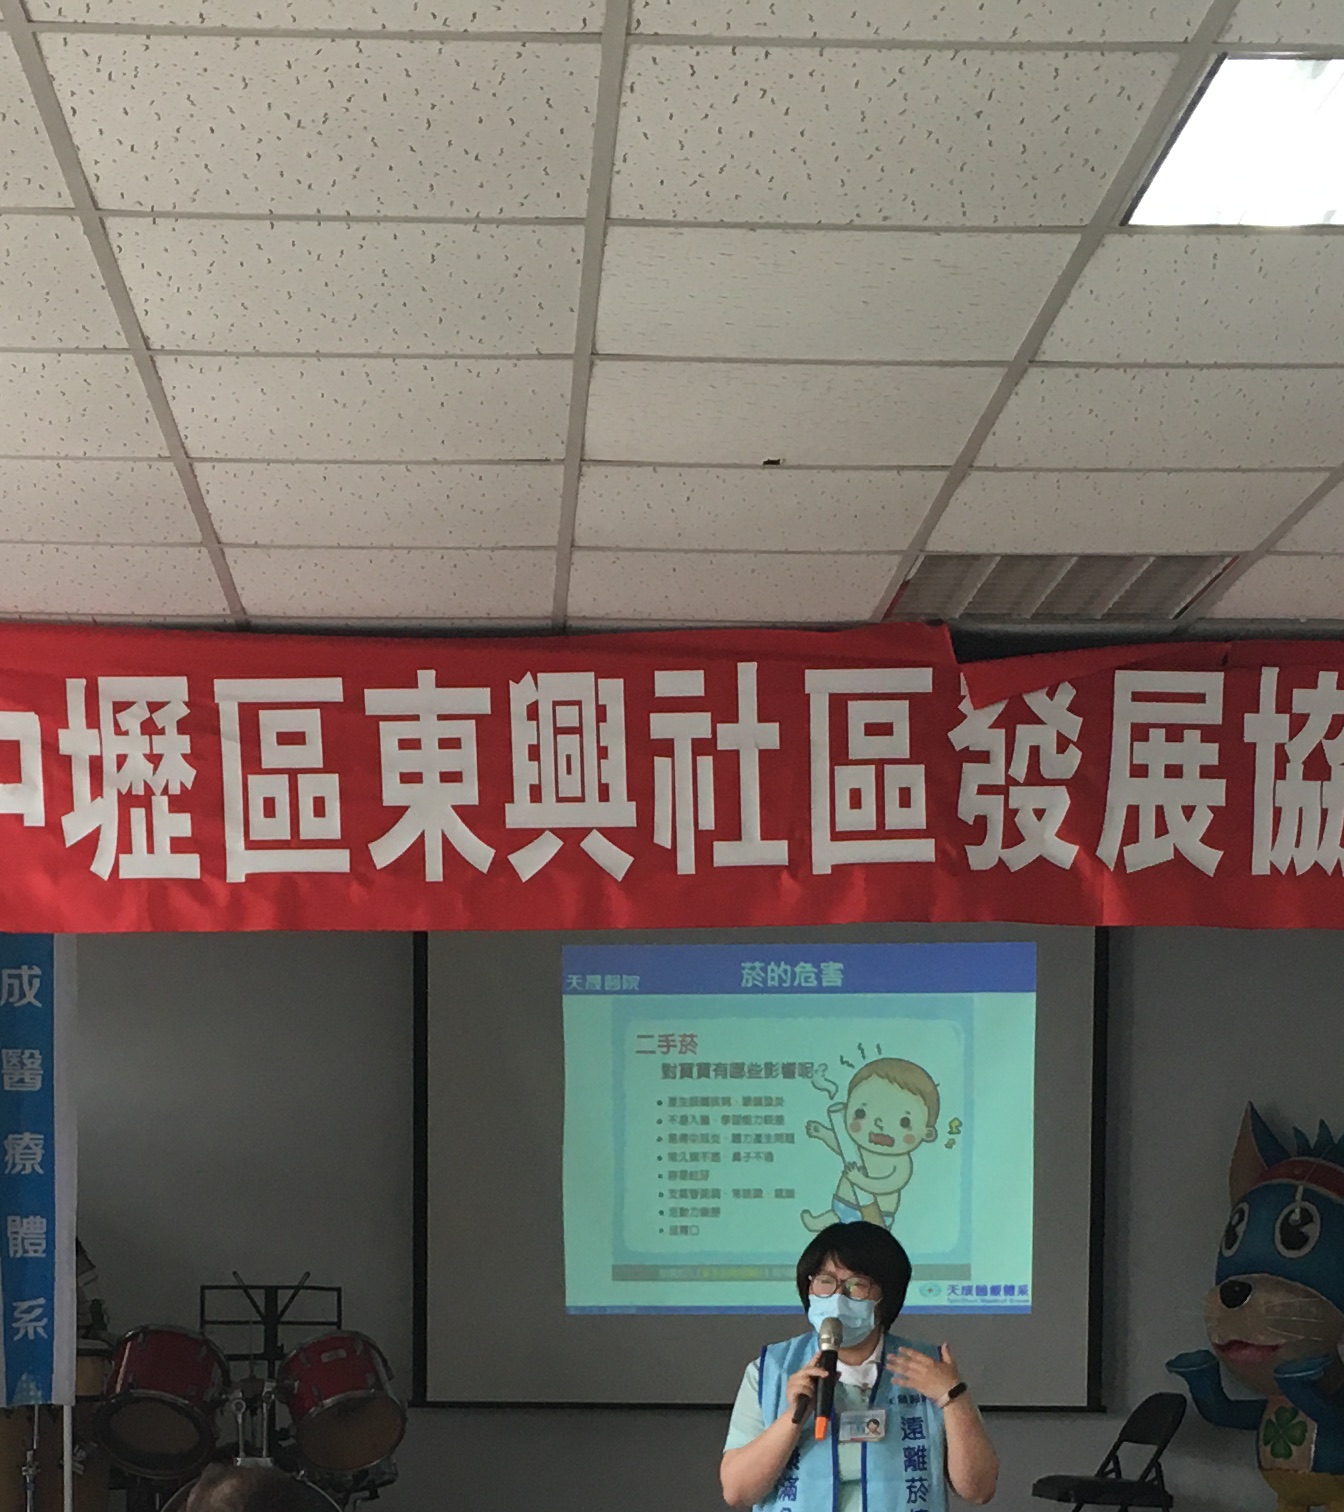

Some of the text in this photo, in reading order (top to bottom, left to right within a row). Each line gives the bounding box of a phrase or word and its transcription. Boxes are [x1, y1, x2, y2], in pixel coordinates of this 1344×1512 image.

[740, 961, 844, 988] 菸的危害
[635, 1033, 699, 1056] 二手菸
[0, 965, 49, 1341] 成醫療體系
